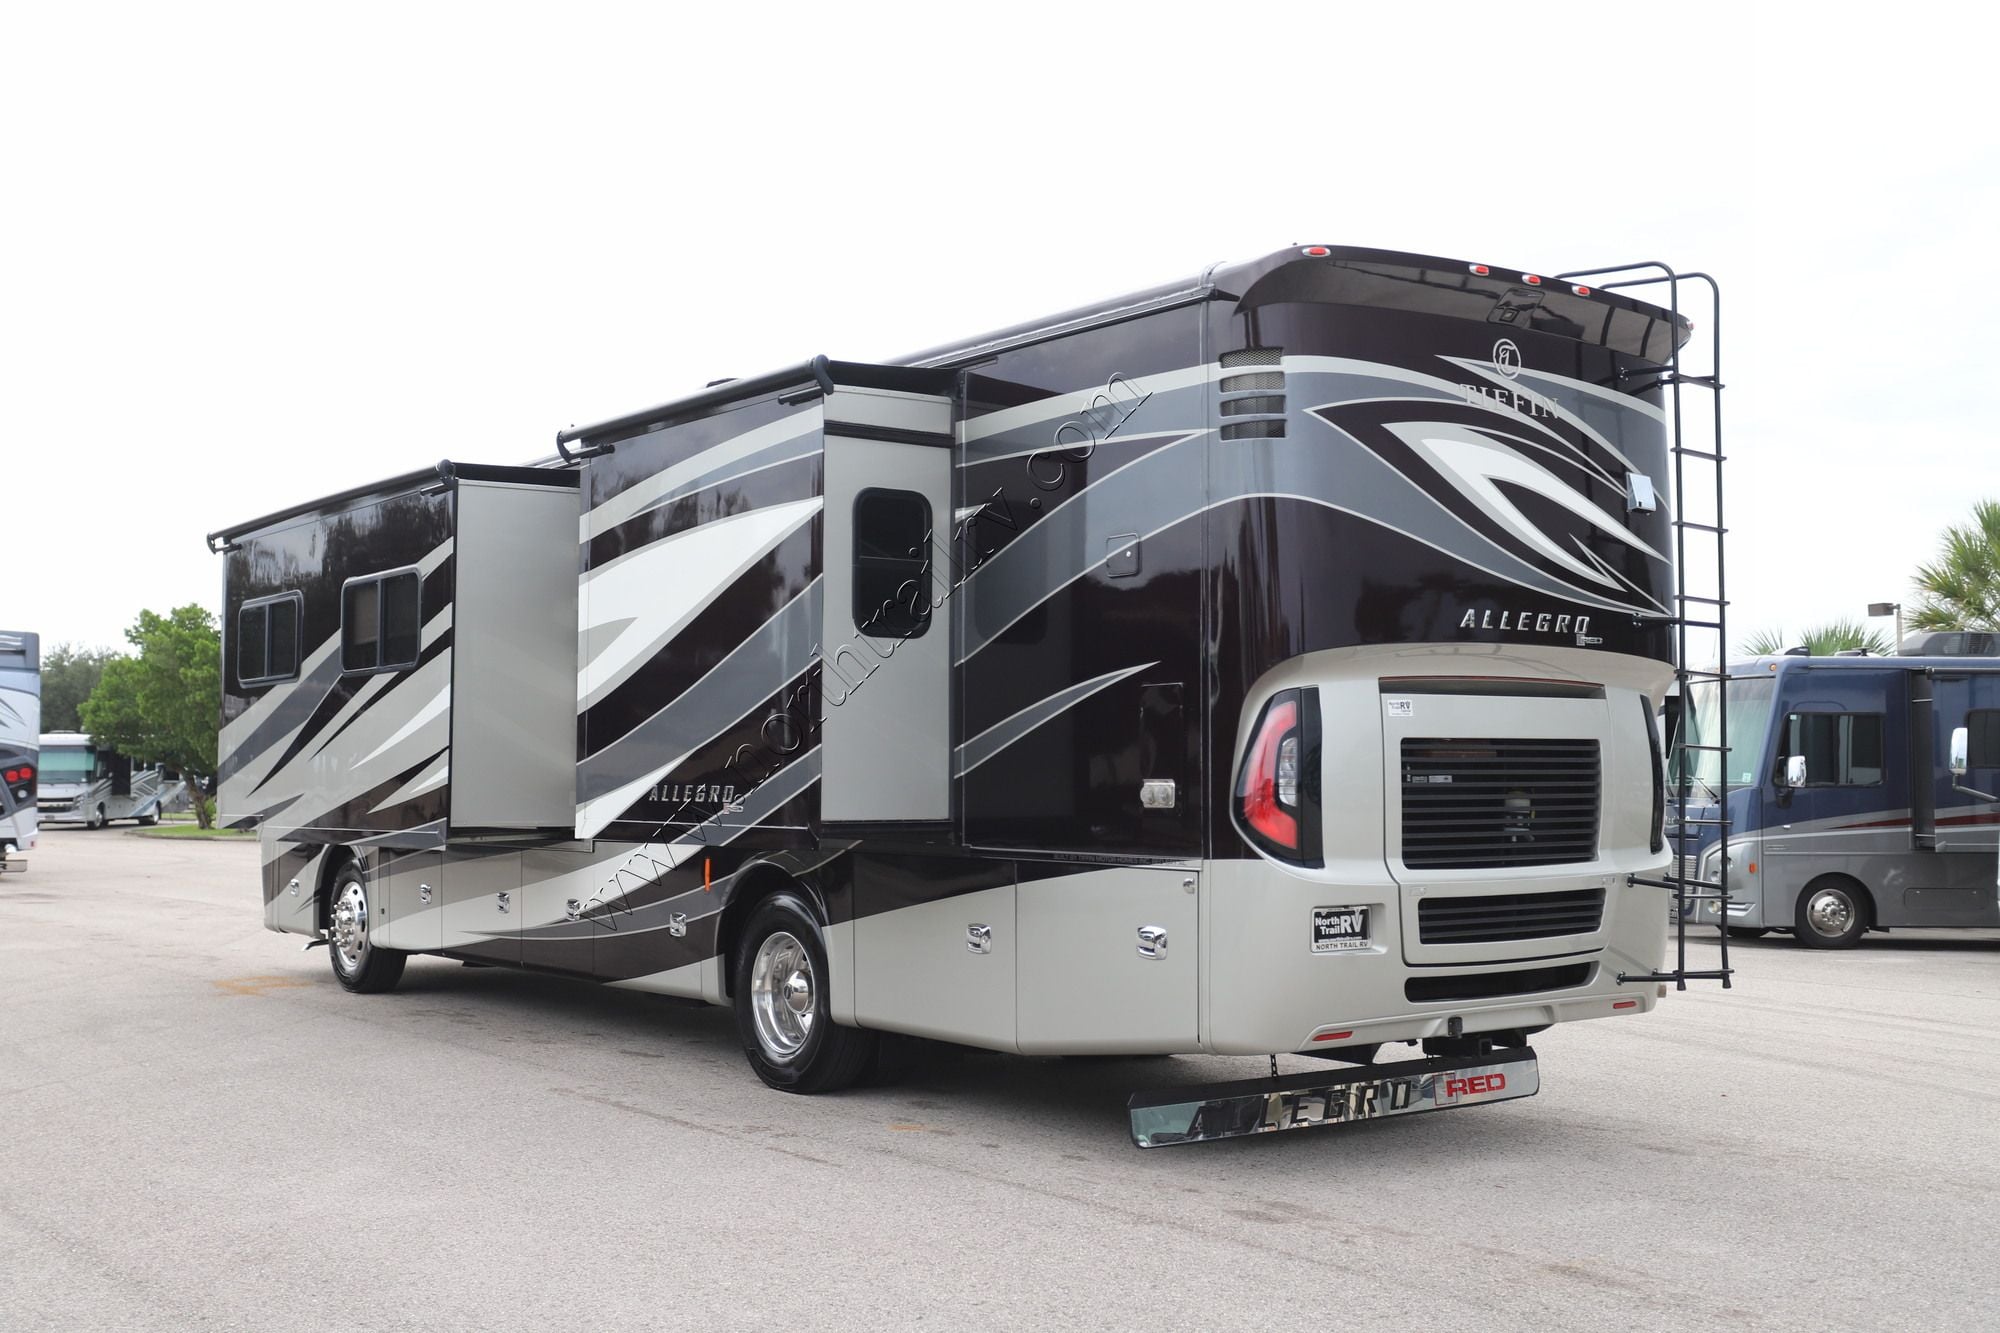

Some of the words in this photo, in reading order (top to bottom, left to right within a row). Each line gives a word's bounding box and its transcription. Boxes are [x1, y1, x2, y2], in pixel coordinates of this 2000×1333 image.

[1459, 383, 1559, 419] TIFFIN
[1459, 608, 1590, 635] ALLEGRO
[649, 784, 735, 803] ALLEGRO
[1315, 917, 1340, 926] North
[1320, 926, 1340, 935] Trail
[1340, 913, 1363, 933] RV
[1446, 1073, 1506, 1097] RED
